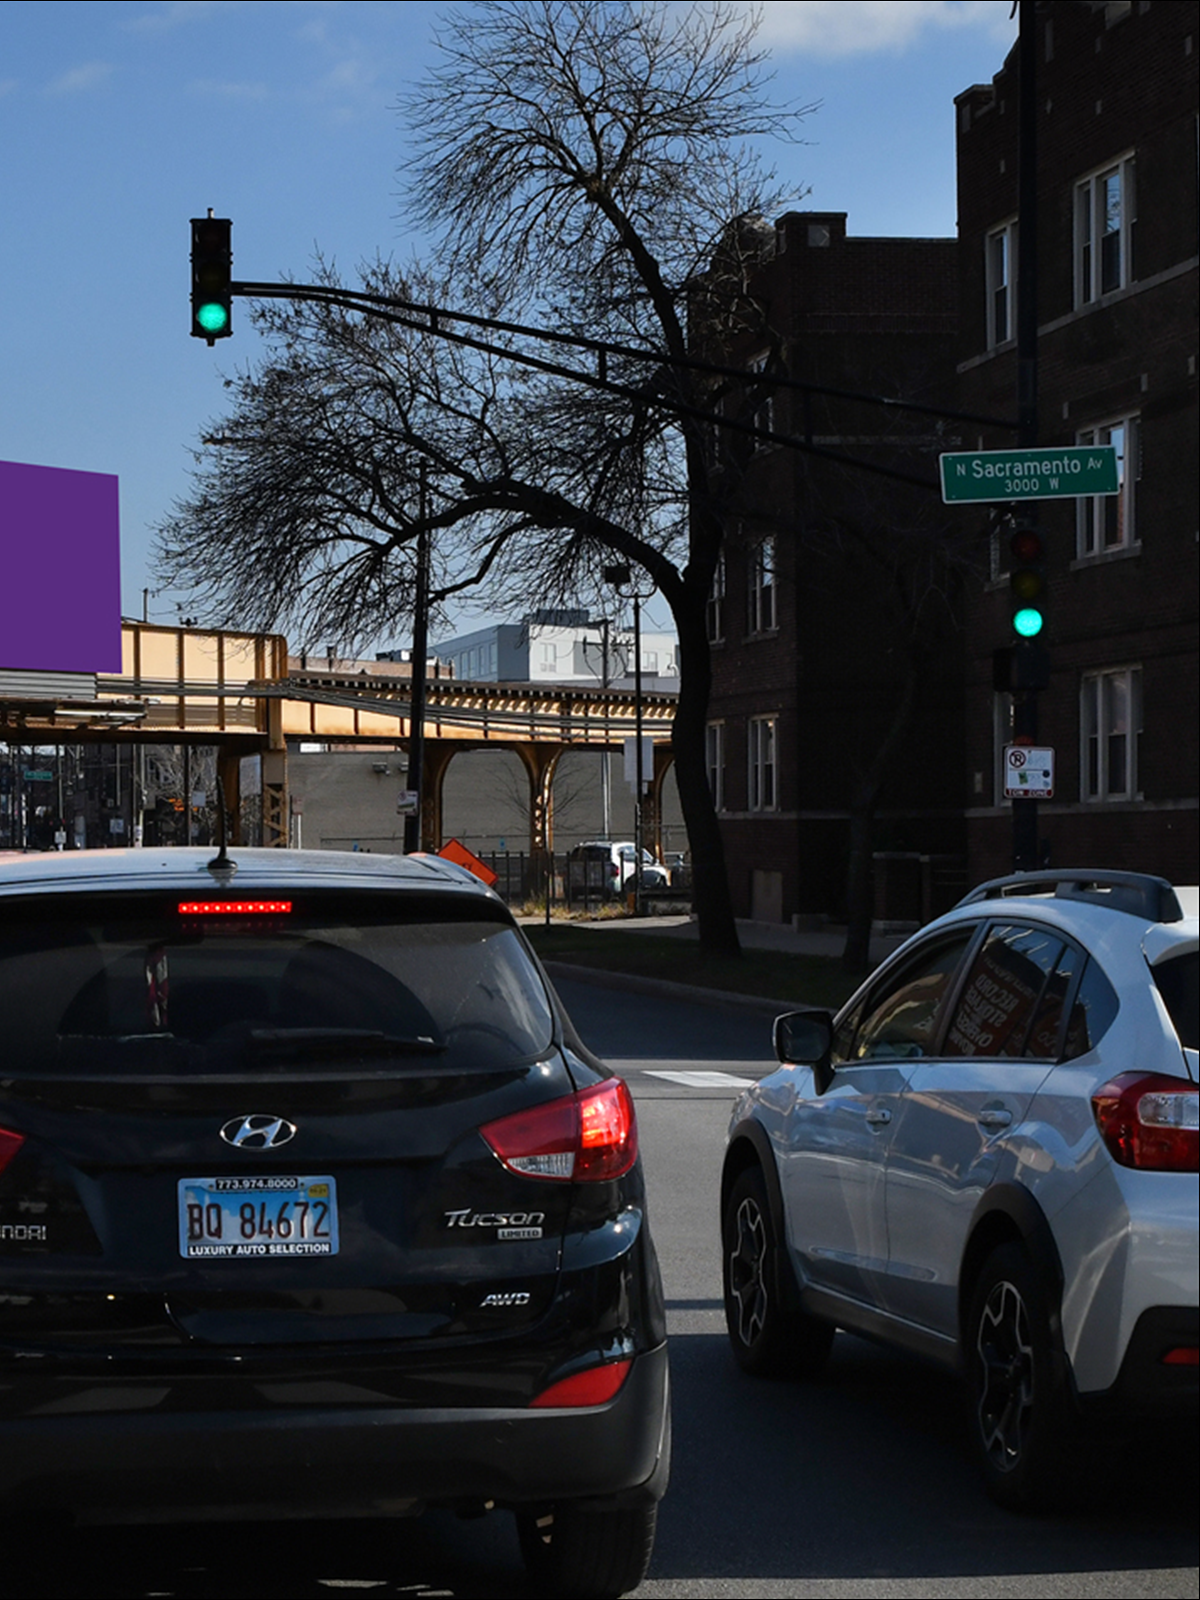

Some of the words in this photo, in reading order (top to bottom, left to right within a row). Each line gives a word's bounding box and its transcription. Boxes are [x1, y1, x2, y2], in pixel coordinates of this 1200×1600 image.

[956, 464, 967, 477] N
[971, 456, 1081, 478] Sacramento
[1087, 457, 1103, 470] Av
[1005, 478, 1039, 493] 3000
[1050, 477, 1060, 490] W
[217, 1179, 296, 1189] 773.974.8000
[187, 1203, 222, 1240] BQ
[239, 1201, 330, 1239] 84672
[501, 1229, 540, 1238] LIMITED
[189, 1245, 234, 1256] LUXURY
[236, 1244, 266, 1255] AUTO
[269, 1242, 330, 1255] SELECTION
[480, 1292, 531, 1308] AWD
